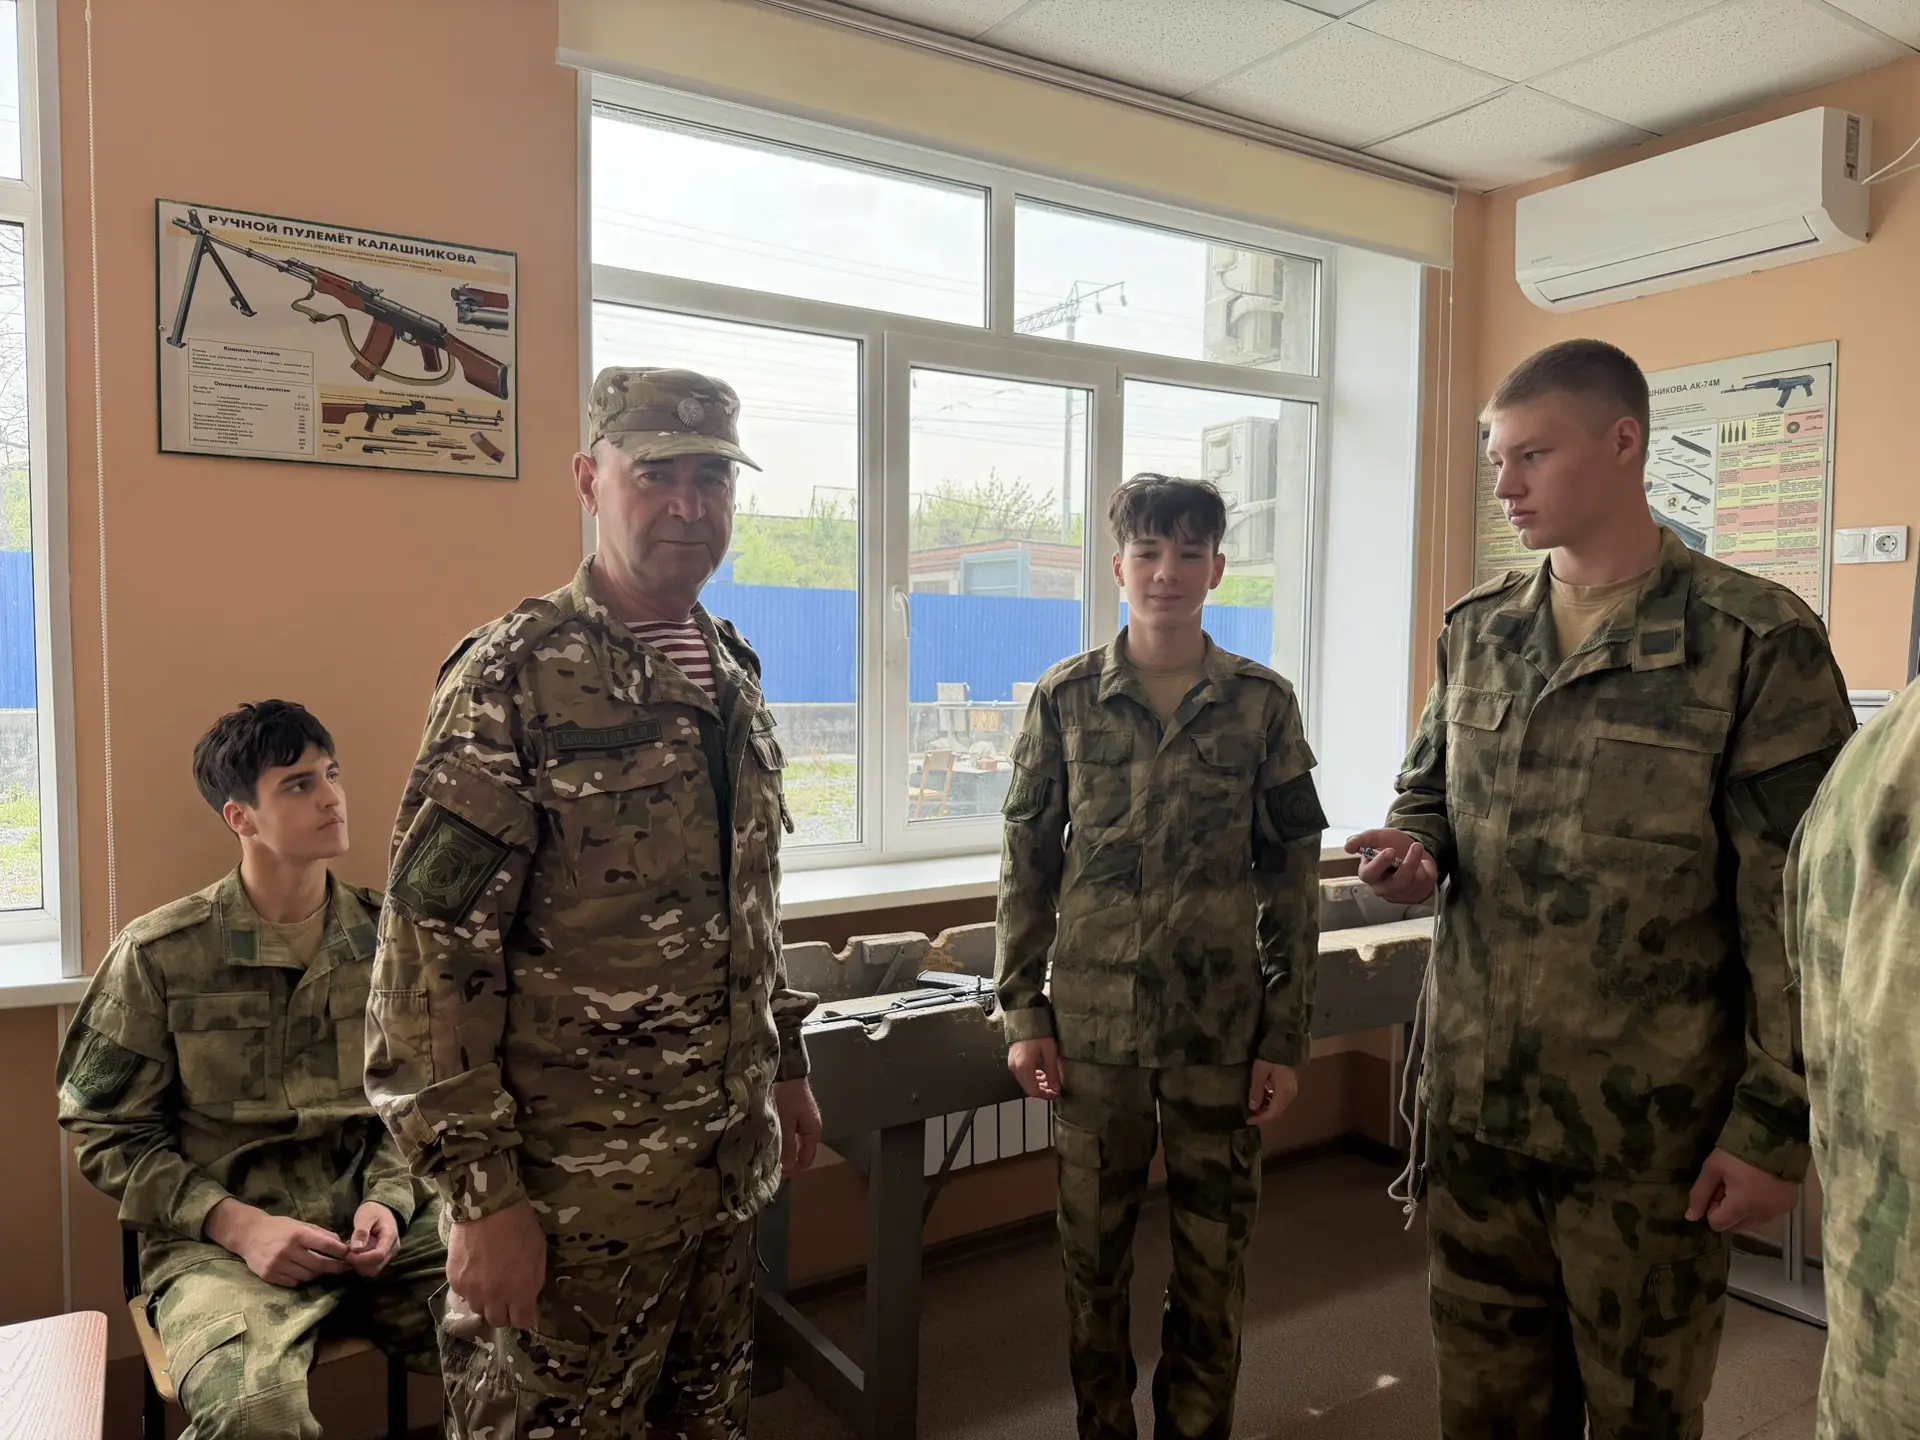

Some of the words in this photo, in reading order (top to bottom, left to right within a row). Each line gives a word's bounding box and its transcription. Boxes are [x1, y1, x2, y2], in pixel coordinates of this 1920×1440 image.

[208, 214, 278, 234] РУЧНОЙ
[283, 226, 353, 245] ПУЛЕМЁТ
[357, 237, 477, 265] КАЛАШНИКОВА
[1689, 378, 1720, 391] АК-74М
